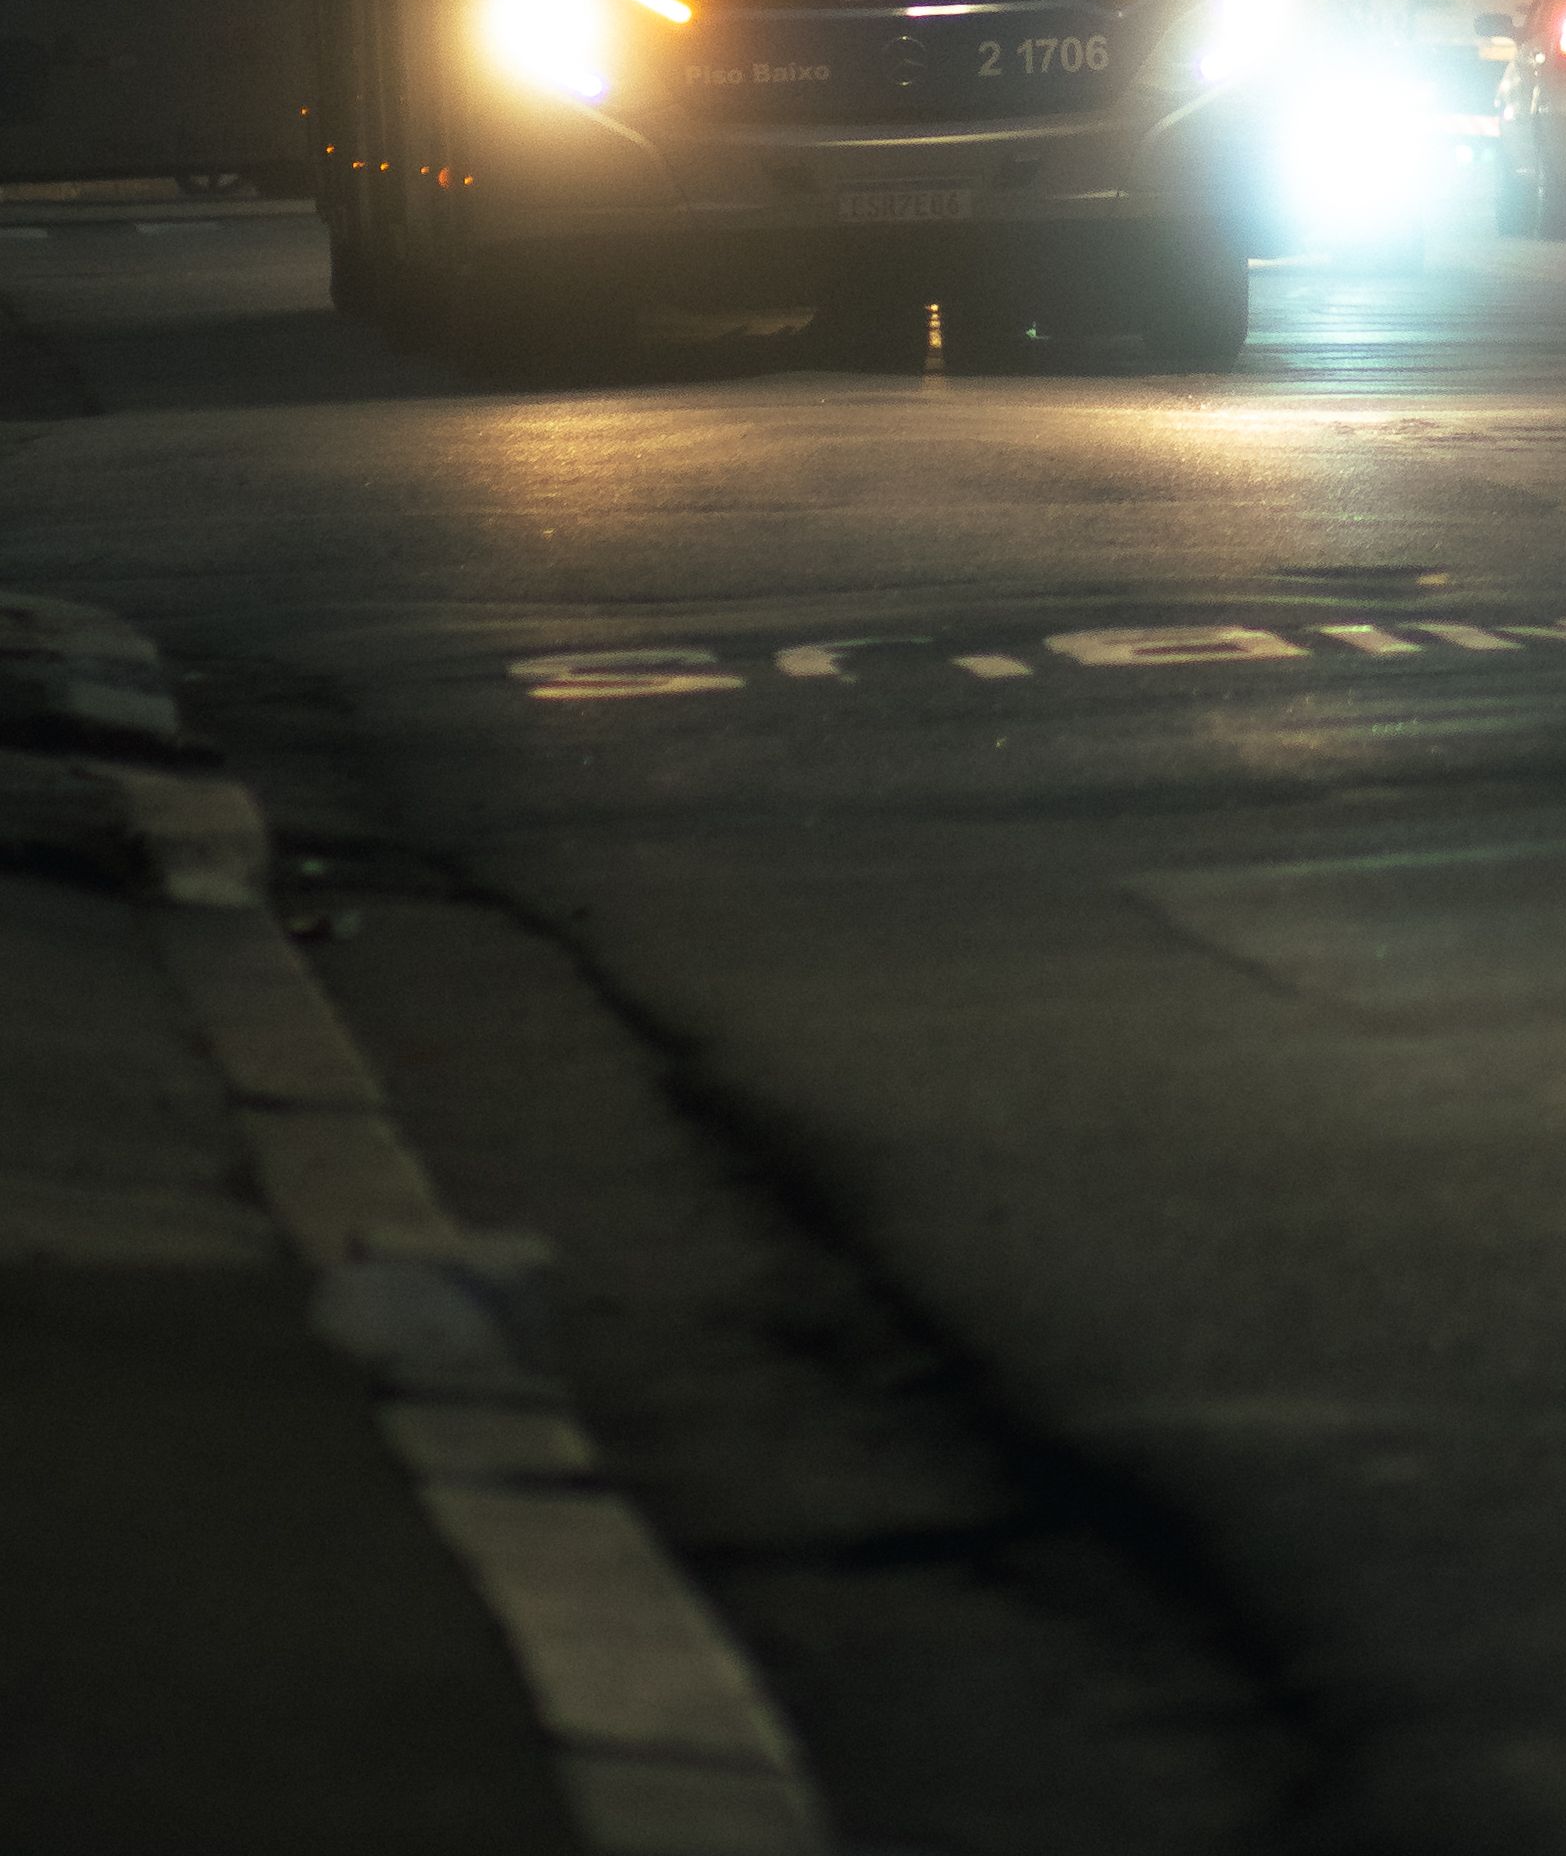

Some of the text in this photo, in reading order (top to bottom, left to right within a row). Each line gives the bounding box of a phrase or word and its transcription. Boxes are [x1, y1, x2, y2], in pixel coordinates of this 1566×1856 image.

[977, 34, 1110, 77] 2 1706
[684, 61, 831, 86] Piso Baixo
